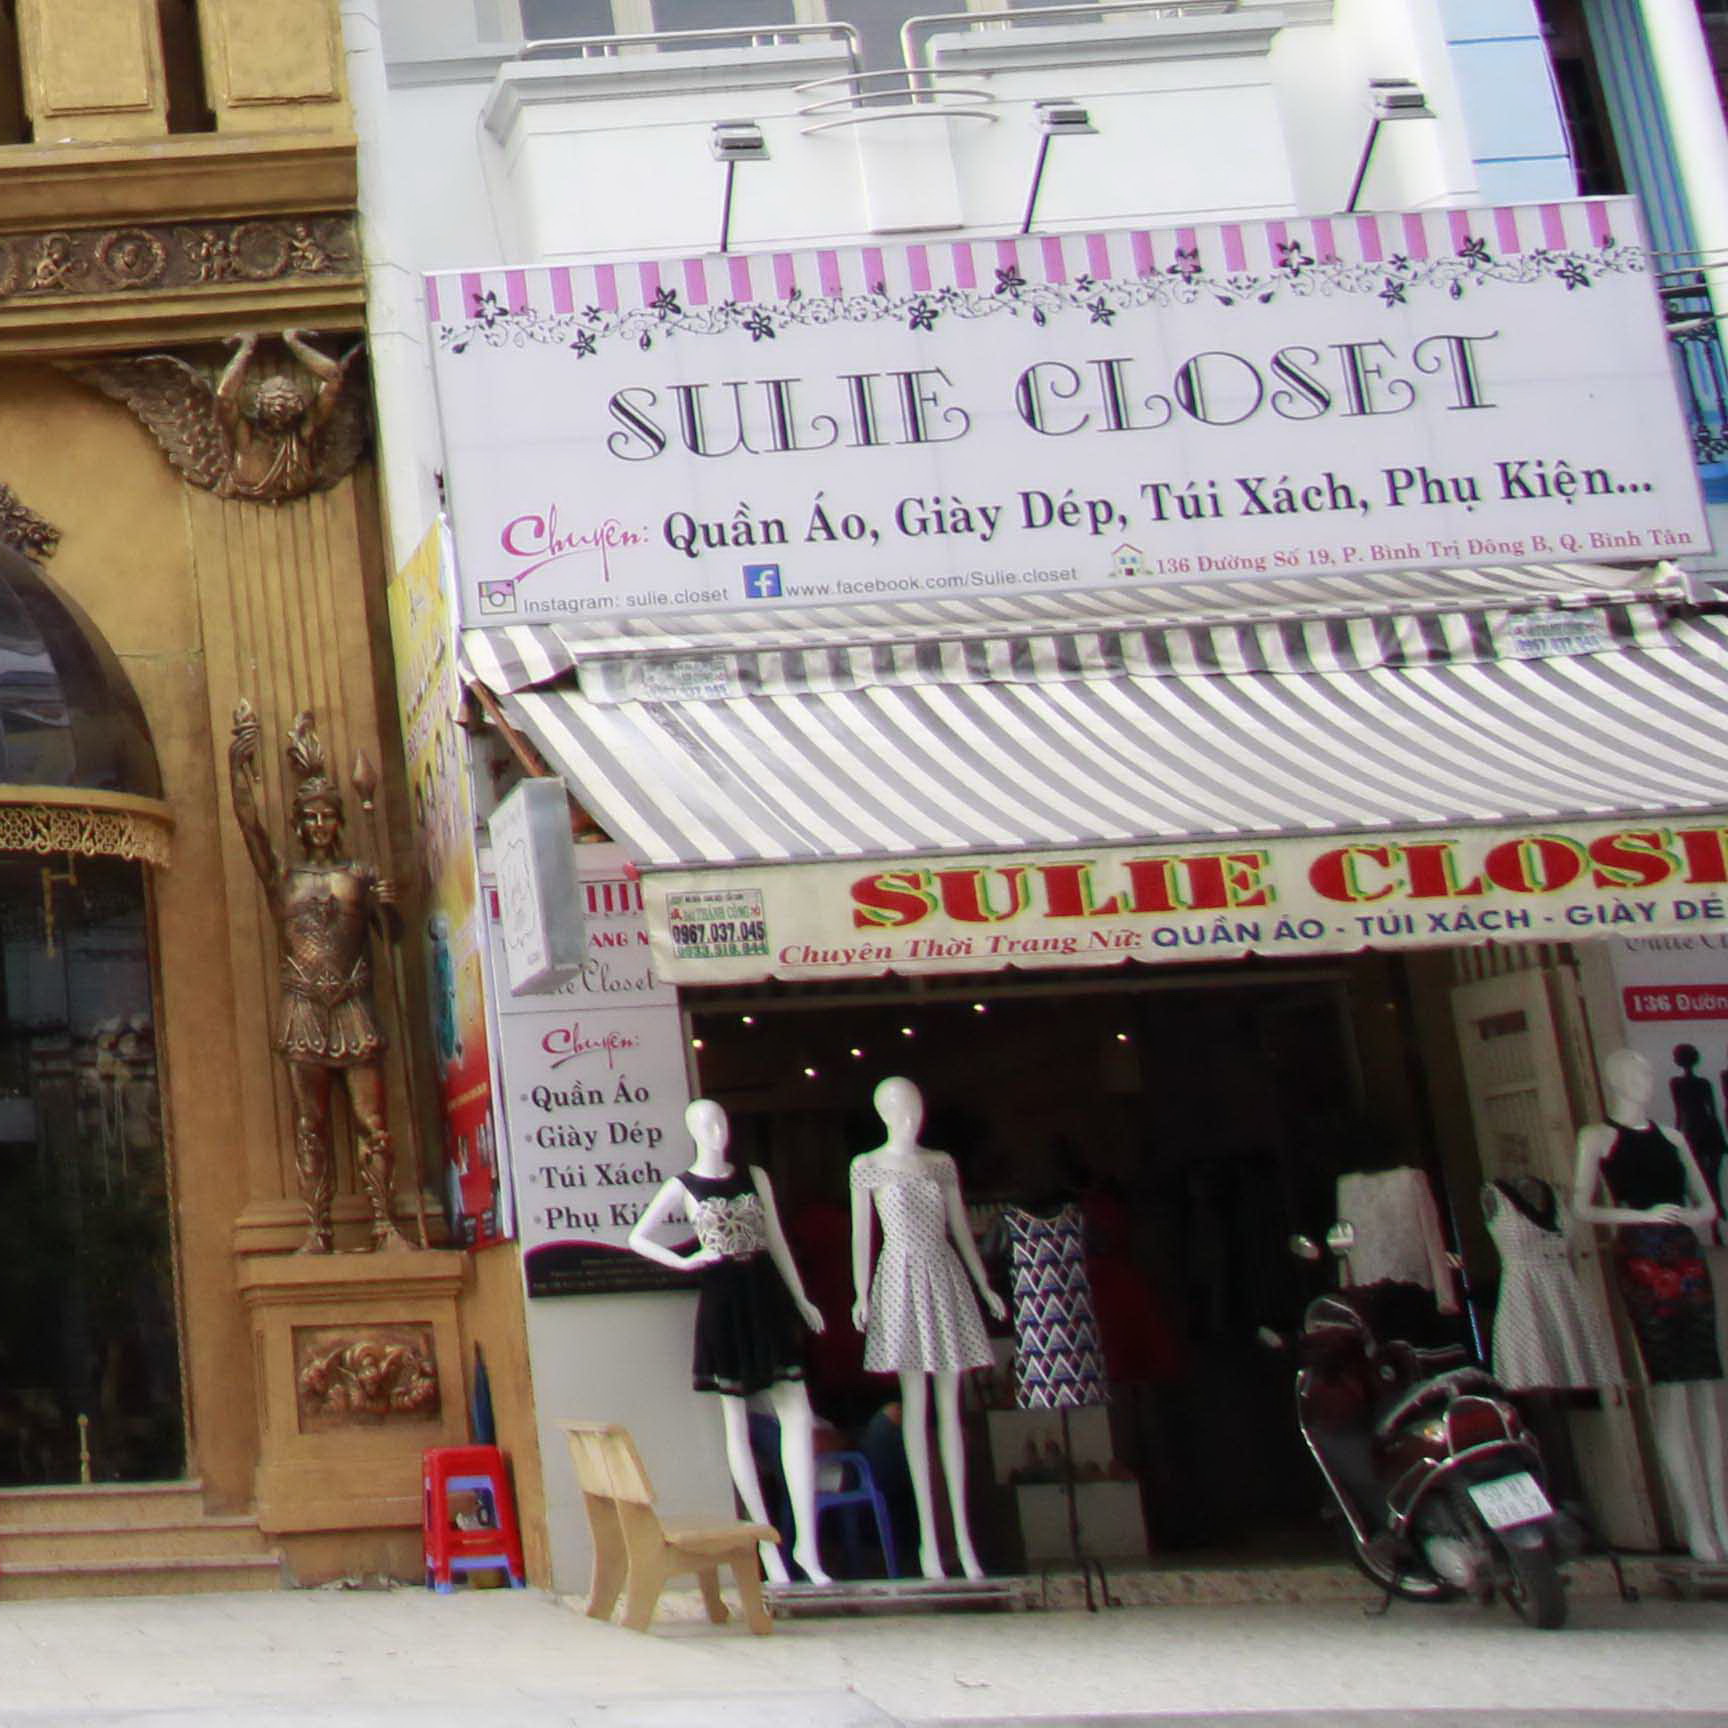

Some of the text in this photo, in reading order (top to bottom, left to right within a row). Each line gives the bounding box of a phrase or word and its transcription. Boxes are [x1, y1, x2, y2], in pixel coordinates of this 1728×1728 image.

[606, 329, 1500, 462] SULIE CLOSET
[662, 501, 789, 559] Quần
[803, 489, 880, 546] Áo,
[893, 494, 1002, 544] Giày
[1020, 481, 1129, 536] Dép,
[1140, 477, 1223, 522] Túi
[1236, 468, 1370, 518] Xách,
[1382, 464, 1482, 506] Phụ
[1497, 458, 1653, 506] Kiện...
[1155, 527, 1693, 576] 136 Đường Số 19, P. Bình Trị Đông B, Q. Bình Tân
[785, 565, 1078, 599] www.facebook.com/Sulie.closet
[522, 585, 730, 616] Instagram: sulie.closet
[850, 849, 1275, 930] SULIE
[672, 920, 766, 945] 0967.037.045
[777, 941, 892, 965] Chuyên
[904, 932, 973, 960] Thời
[984, 933, 1078, 956] Trang
[1087, 928, 1142, 949] Nữ:
[1150, 915, 1260, 949] QUẦN
[1273, 912, 1325, 941] ÁO
[1354, 907, 1415, 936] TÚI
[1427, 904, 1531, 932] XÁCH
[1565, 896, 1657, 926] GIÀY
[530, 1073, 650, 1111] Quần Áo
[536, 1119, 663, 1153] Giày Dép
[538, 1160, 663, 1190] Túi Xách
[545, 1205, 600, 1229] Phụ
